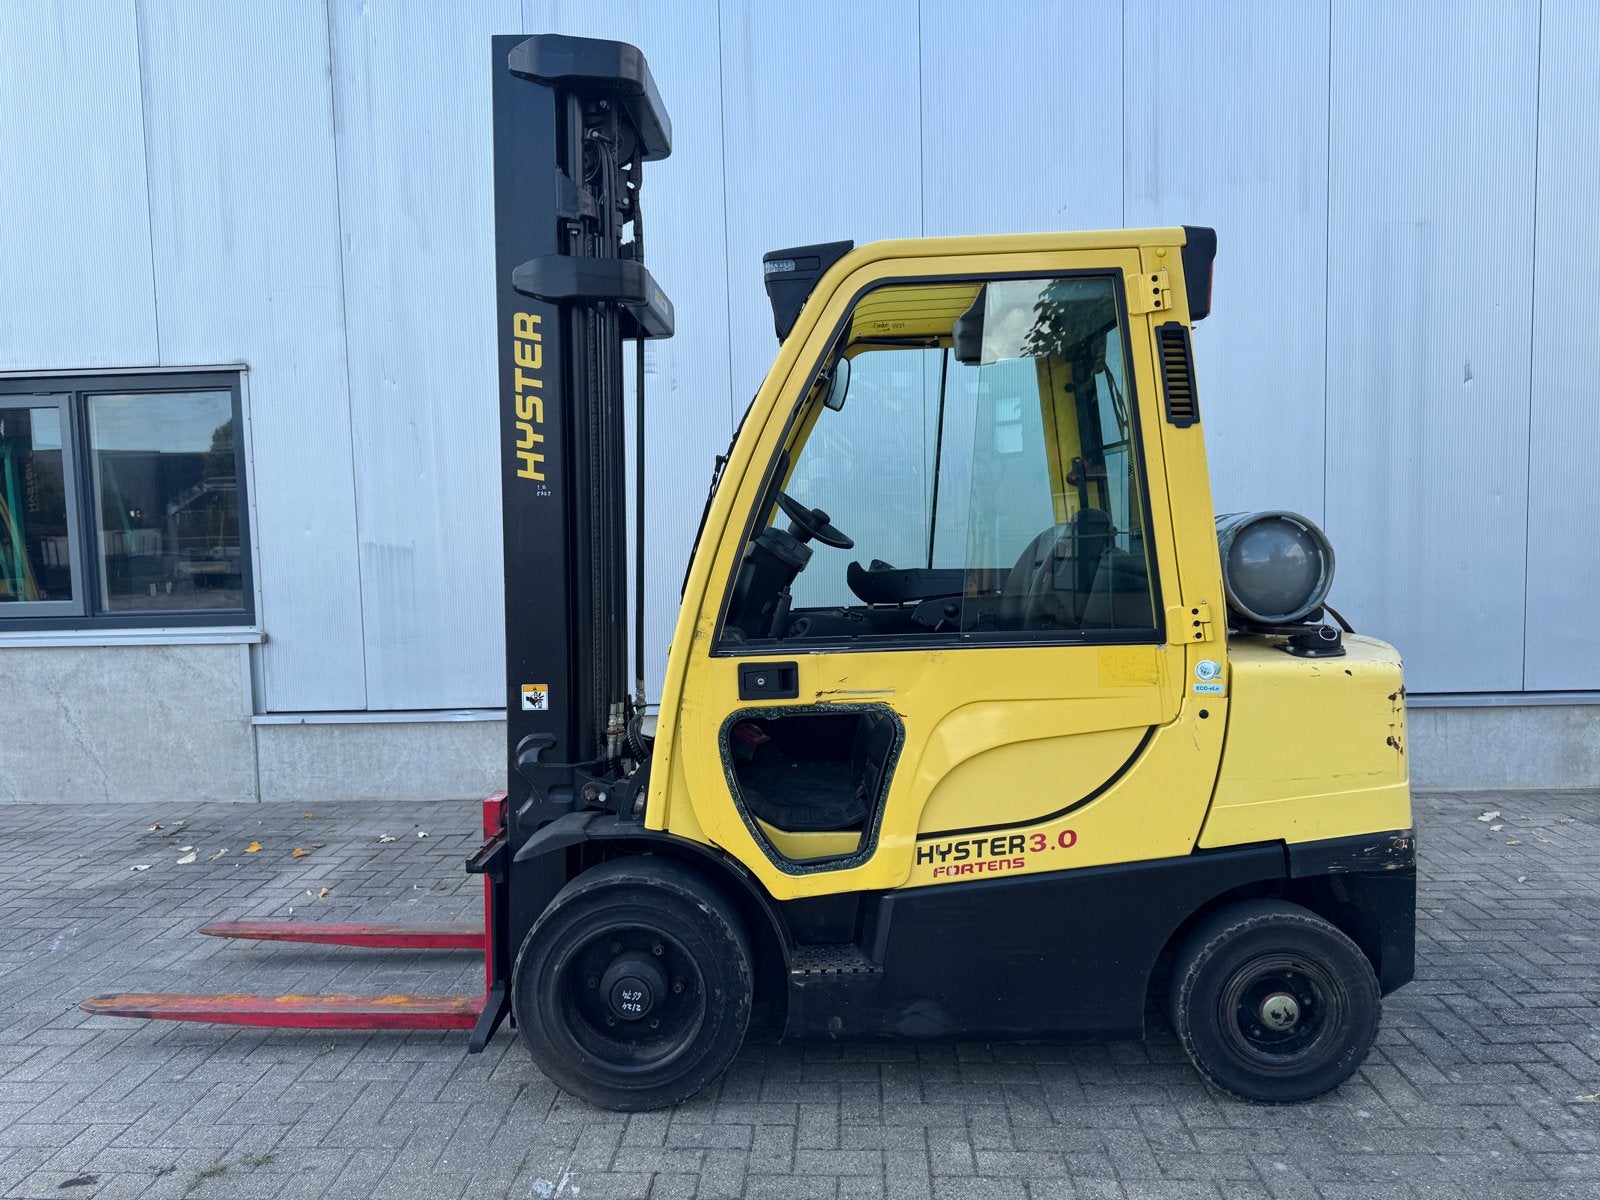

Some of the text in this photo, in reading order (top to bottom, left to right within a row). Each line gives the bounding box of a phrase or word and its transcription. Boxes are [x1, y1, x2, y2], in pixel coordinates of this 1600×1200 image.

[513, 312, 544, 481] HYSTER
[916, 829, 1078, 865] HYSTER 3.0
[933, 857, 1025, 878] FORTENS
